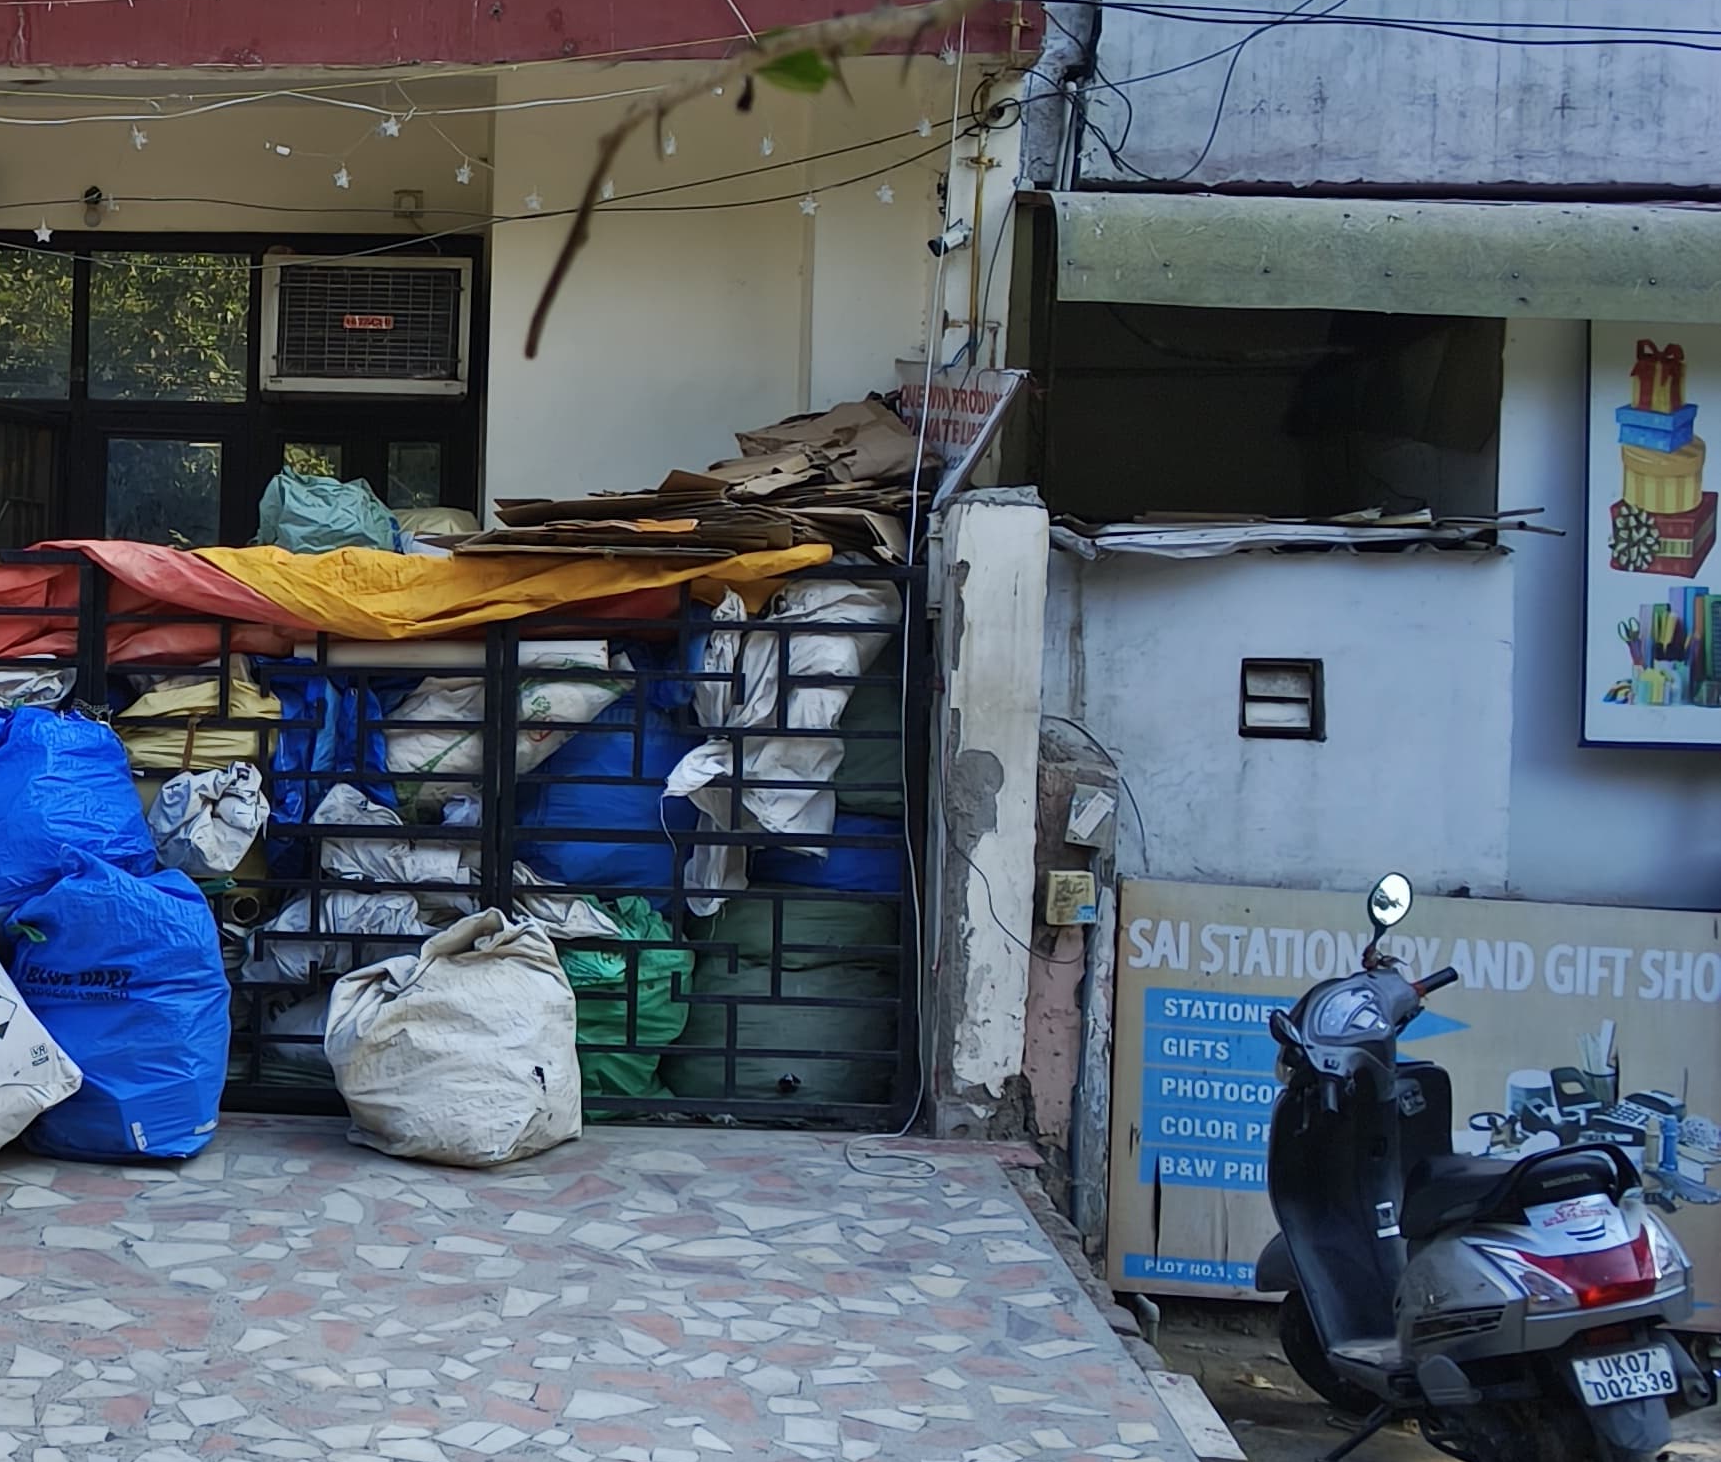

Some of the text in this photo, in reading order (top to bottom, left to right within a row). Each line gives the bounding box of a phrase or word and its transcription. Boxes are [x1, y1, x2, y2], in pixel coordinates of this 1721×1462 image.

[1128, 918, 1189, 971] SAI
[1451, 937, 1536, 992] AND
[1544, 943, 1634, 998] GIFT
[1164, 998, 1290, 1024] STATIONE
[1162, 1037, 1230, 1061] GIFTS
[1160, 1116, 1238, 1141] COLOR
[1160, 1156, 1216, 1178] B&W
[1144, 1259, 1183, 1274] PLOT
[1597, 1352, 1650, 1378] UK07
